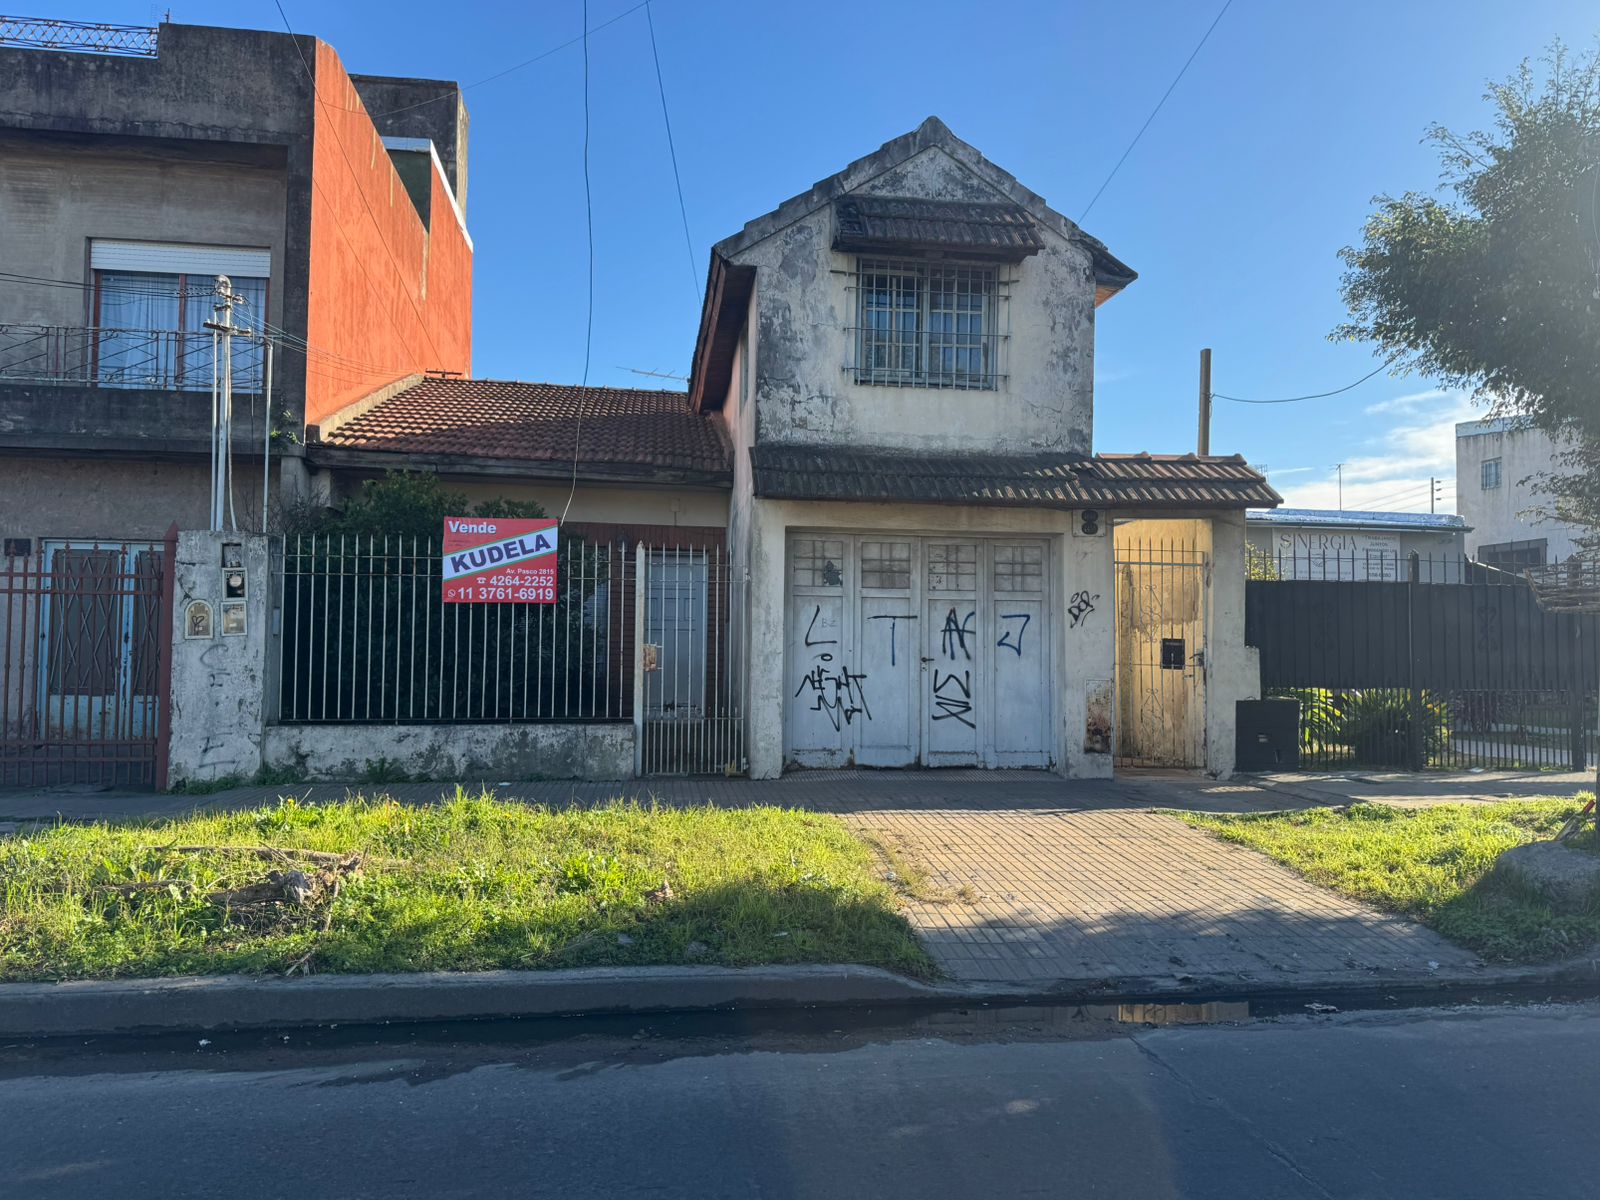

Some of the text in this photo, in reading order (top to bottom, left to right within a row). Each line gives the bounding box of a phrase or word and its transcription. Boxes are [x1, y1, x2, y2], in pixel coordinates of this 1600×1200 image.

[448, 521, 497, 533] Vende
[1280, 533, 1357, 550] SINERGIA
[450, 534, 551, 573] KUDELA
[490, 576, 554, 587] 4264-2252
[458, 587, 554, 600] 11 3761-6919
